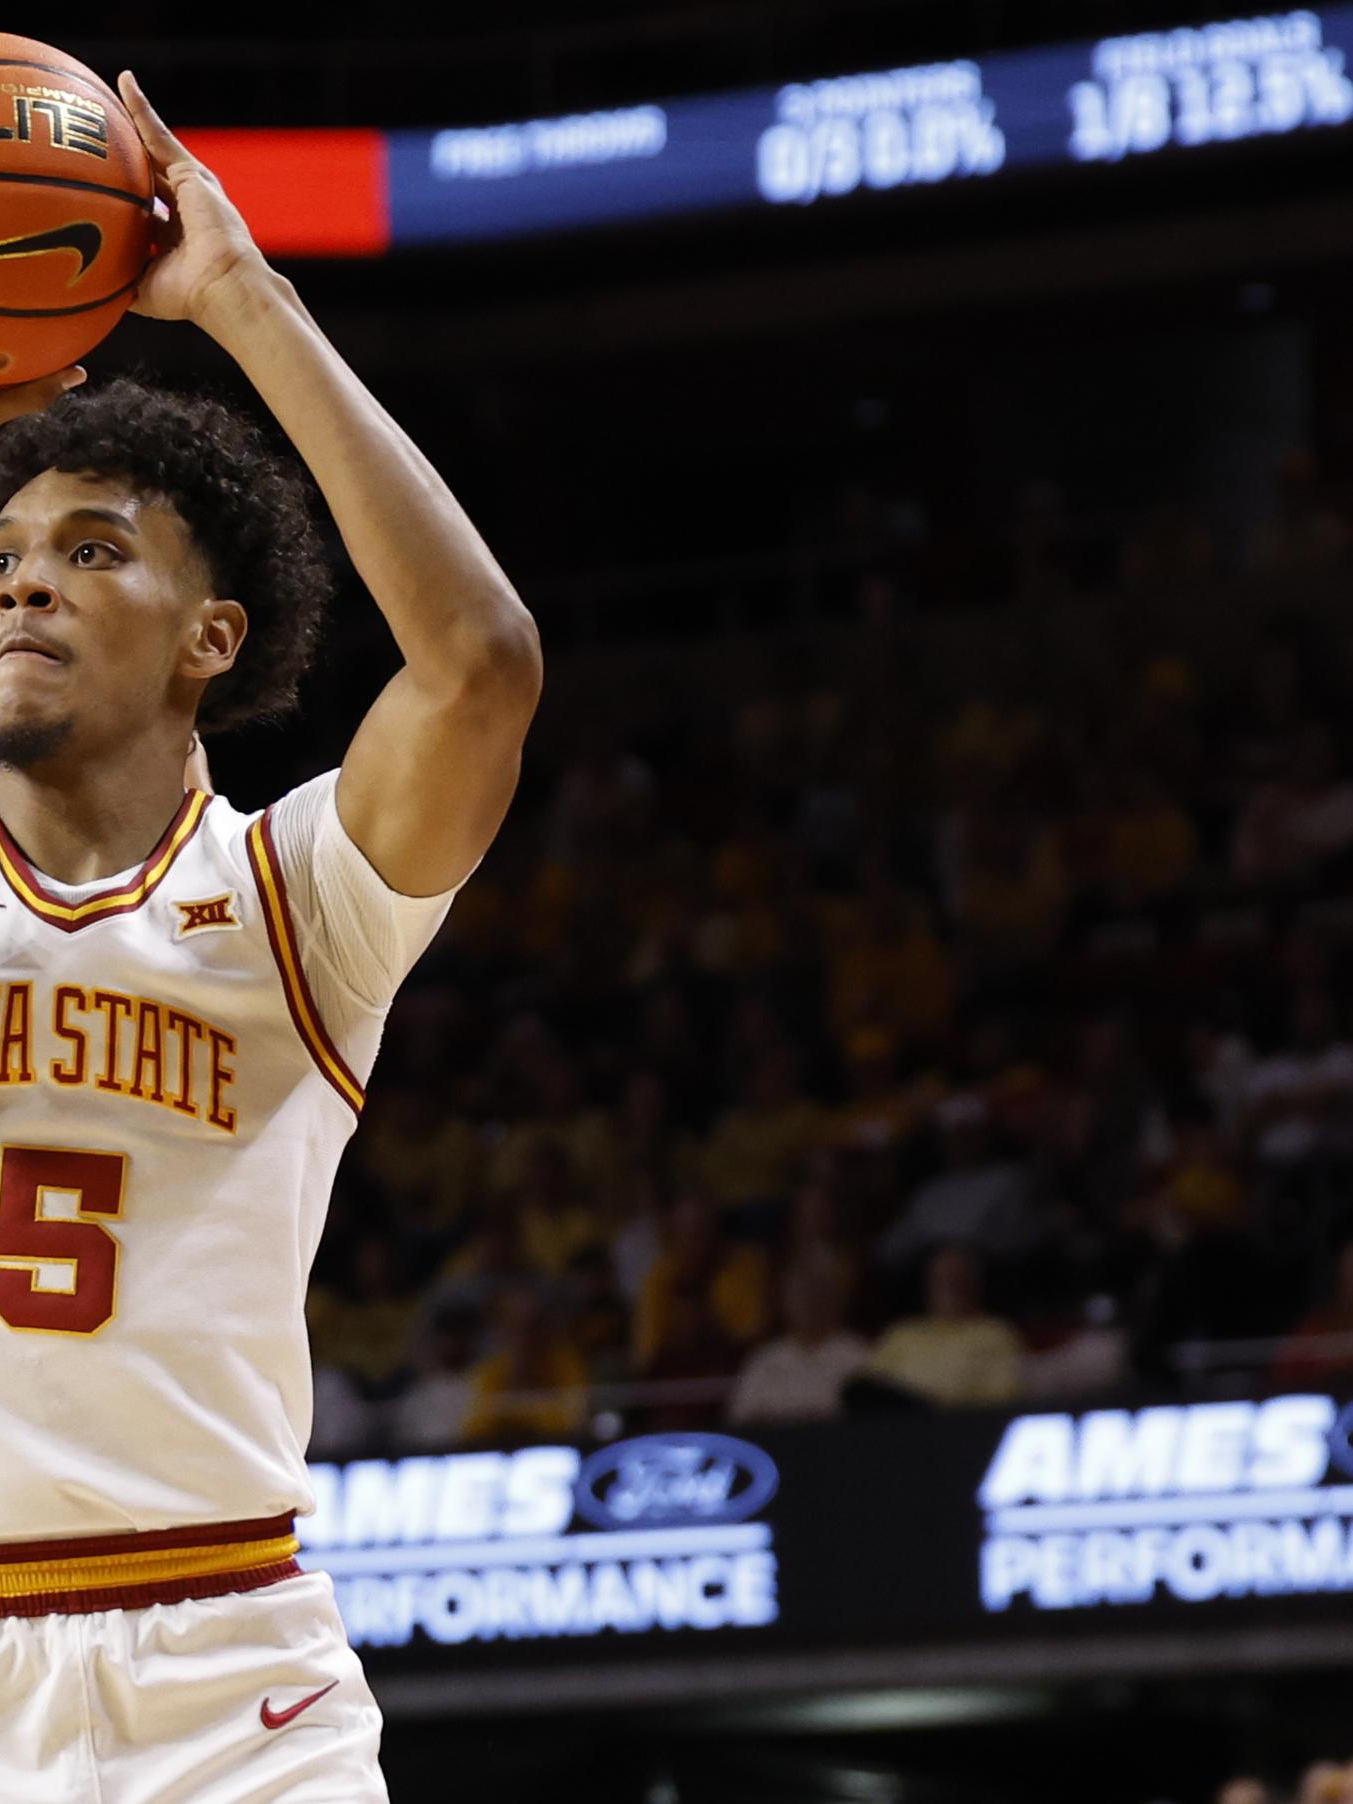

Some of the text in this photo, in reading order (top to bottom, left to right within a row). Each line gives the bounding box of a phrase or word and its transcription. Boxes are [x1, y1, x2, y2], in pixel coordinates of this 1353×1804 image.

[50, 982, 239, 1136] STATE
[978, 1394, 1337, 1508] AMES
[331, 1549, 781, 1648] RFORMANCE
